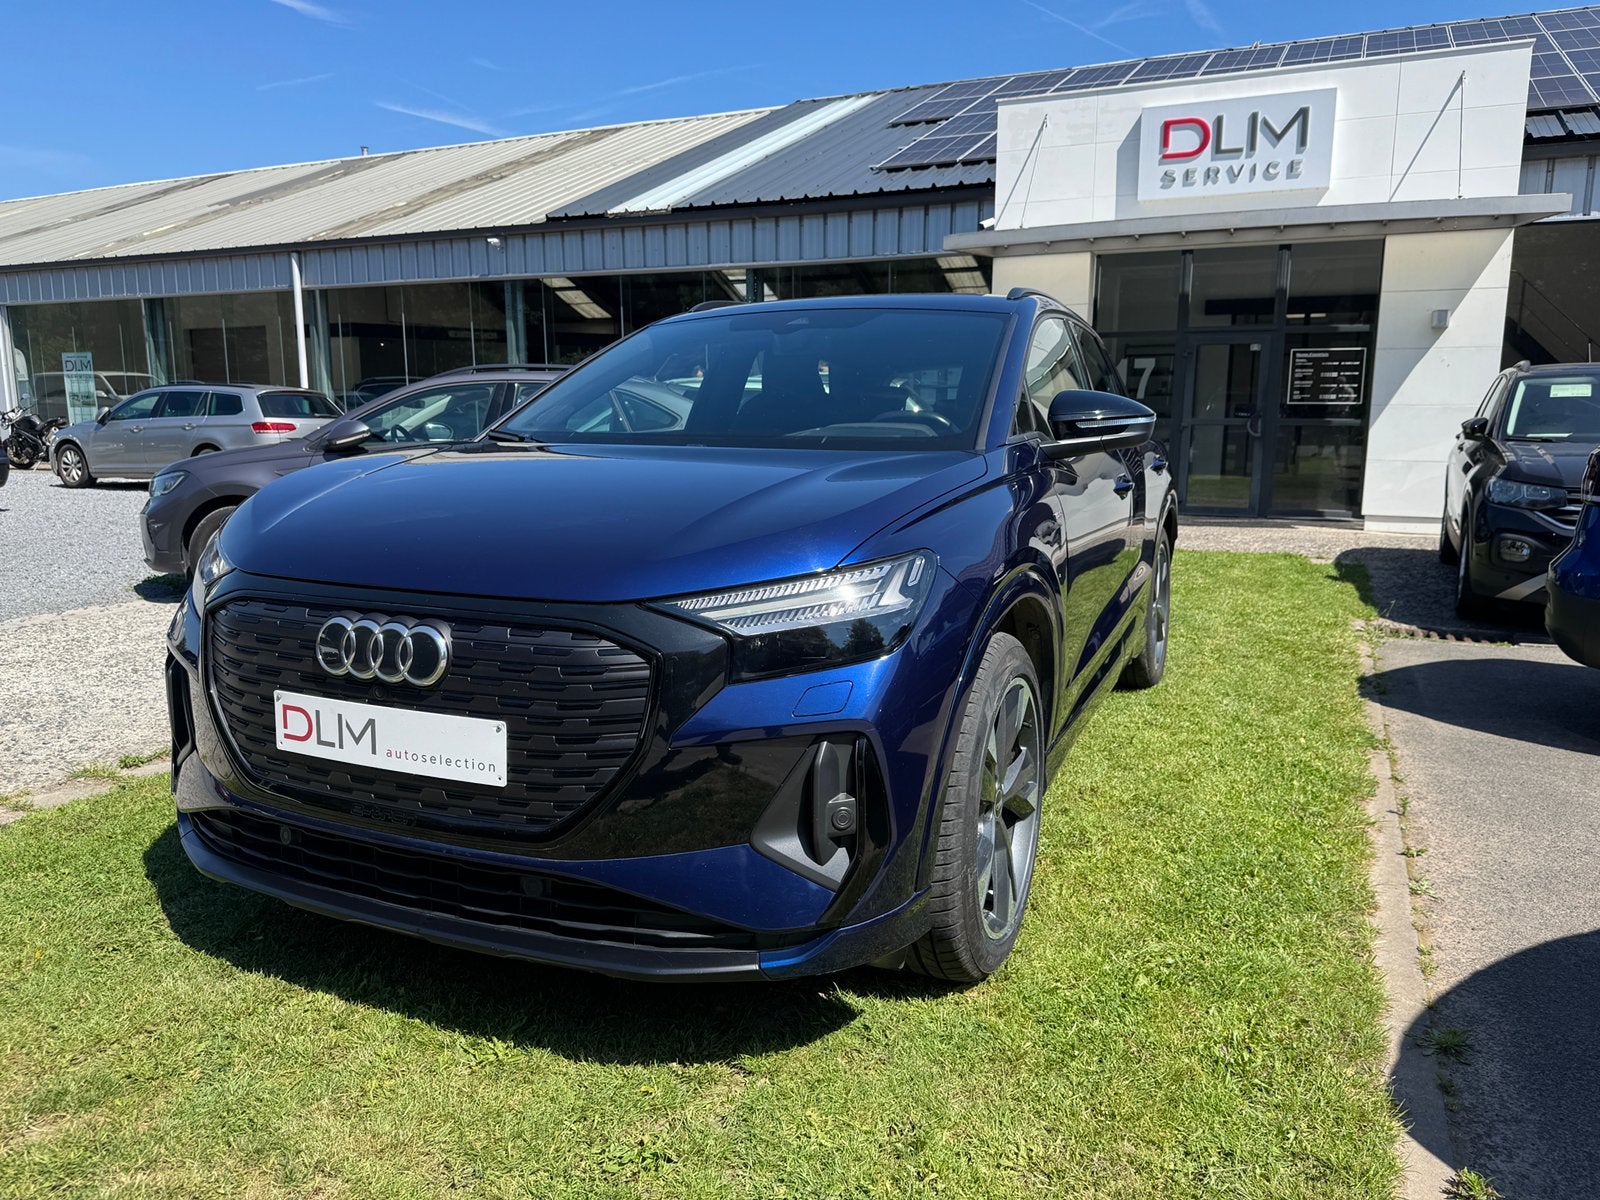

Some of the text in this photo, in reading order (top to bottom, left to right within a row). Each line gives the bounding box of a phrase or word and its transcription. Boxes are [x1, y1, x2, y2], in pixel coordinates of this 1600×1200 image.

[1161, 106, 1310, 160] DLM
[1162, 159, 1304, 188] SERVICE
[65, 359, 92, 372] DLM
[282, 703, 377, 755] DLM
[386, 747, 496, 772] autoselection
